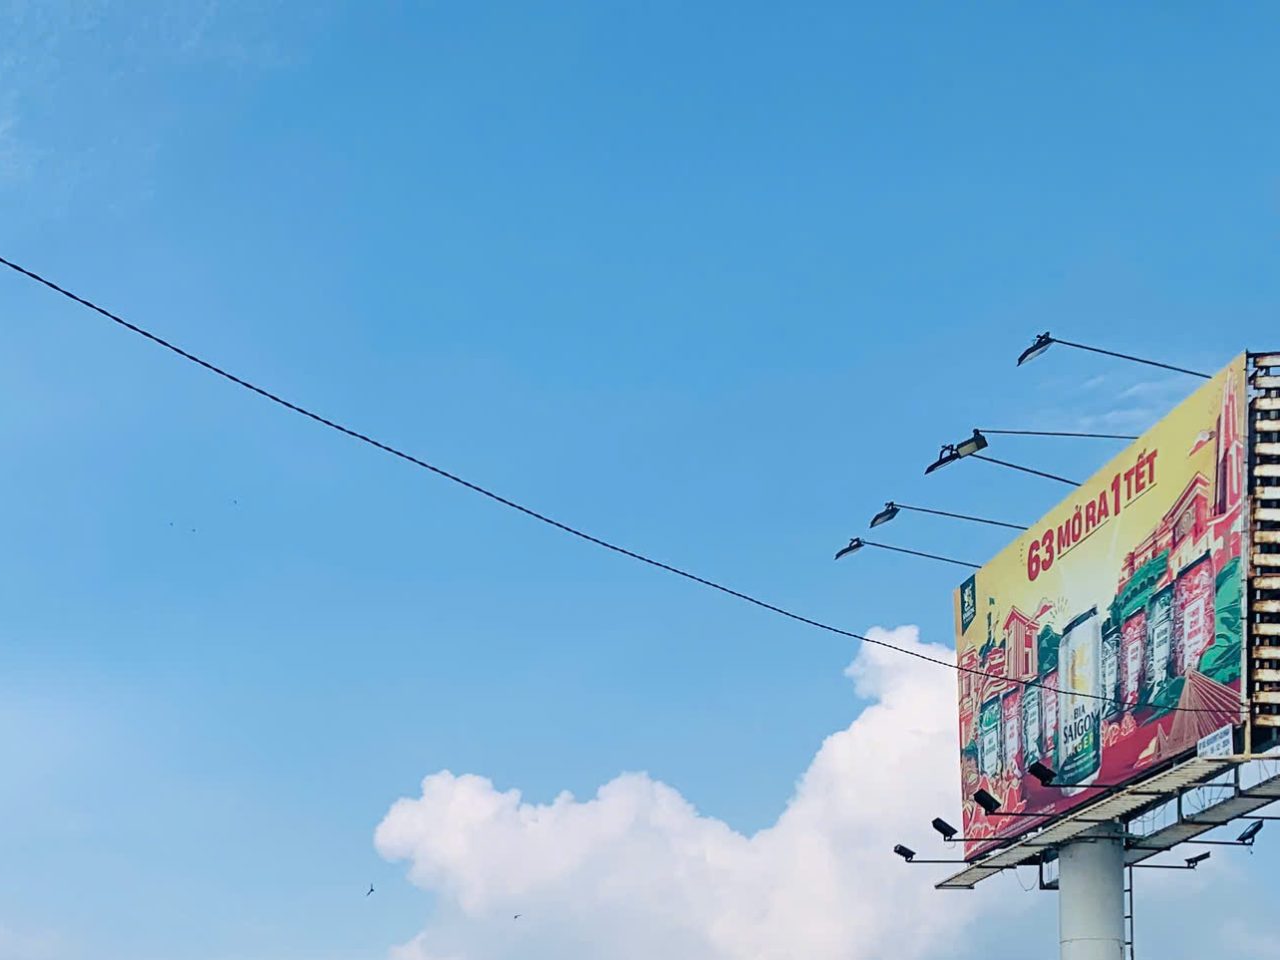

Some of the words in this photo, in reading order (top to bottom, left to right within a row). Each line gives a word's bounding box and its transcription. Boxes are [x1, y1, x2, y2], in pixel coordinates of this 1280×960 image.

[1027, 528, 1055, 582] 63
[1085, 490, 1110, 534] RA
[1111, 473, 1121, 517] 1
[1124, 448, 1158, 501] TẾT
[1073, 704, 1086, 720] BIA
